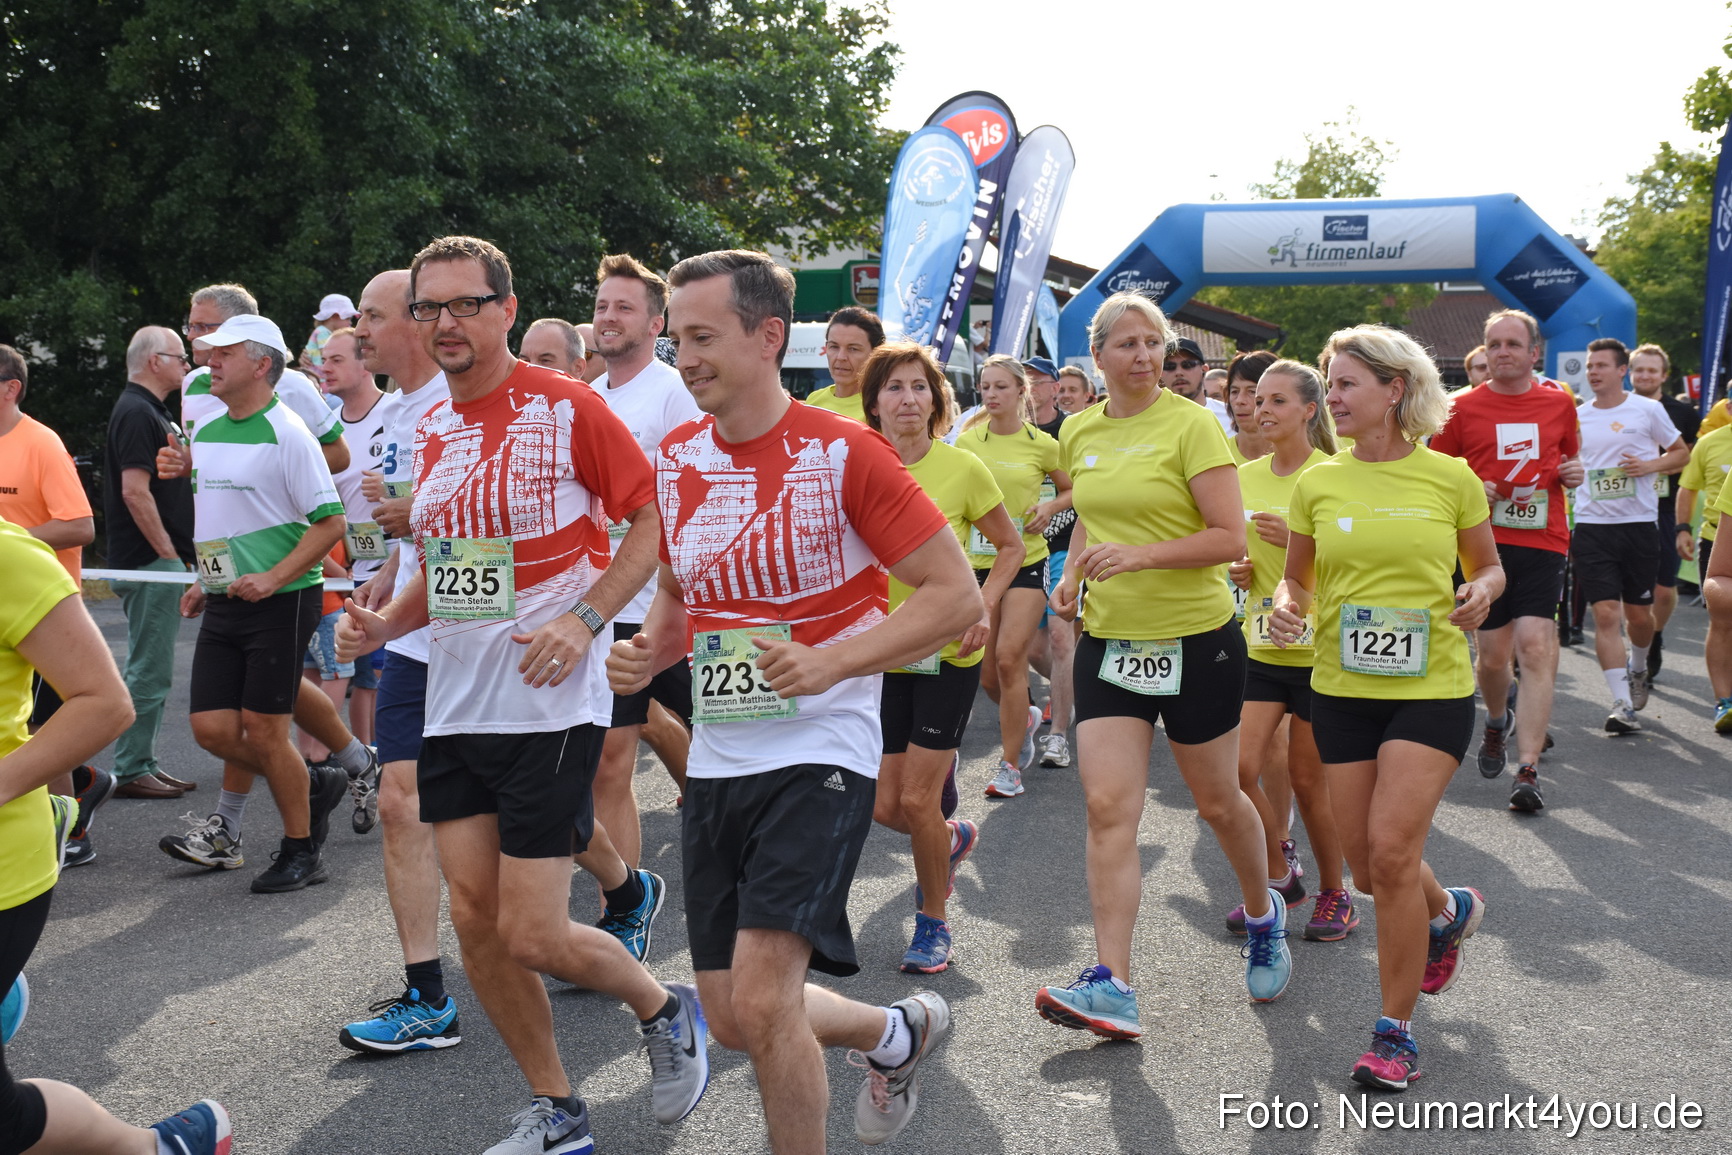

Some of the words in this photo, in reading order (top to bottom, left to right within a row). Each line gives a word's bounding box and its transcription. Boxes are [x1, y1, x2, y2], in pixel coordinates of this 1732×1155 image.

[1021, 150, 1057, 242] Fischer
[1035, 161, 1062, 236] AUTOMOBILE
[1306, 240, 1408, 261] firmenlauf
[1117, 278, 1171, 290] Fischer
[1594, 477, 1629, 492] 1357
[1505, 503, 1538, 519] 469
[351, 535, 375, 550] 799
[697, 532, 727, 545] 26.22
[486, 559, 507, 567] 2019
[434, 566, 500, 596] 2235
[438, 596, 466, 605] Wittmann
[467, 596, 494, 605] Stefan
[1349, 629, 1412, 658] 1221
[1353, 654, 1390, 664] Fraunhofer
[1391, 657, 1409, 665] Ruth
[1114, 655, 1172, 679] 1209
[1122, 675, 1142, 685] Brede
[1142, 679, 1161, 687] Sonja
[703, 698, 738, 707] Wittmann
[739, 694, 777, 704] Matthias
[725, 703, 782, 713] Neumarkt-Parsberg
[823, 780, 846, 792] adidas
